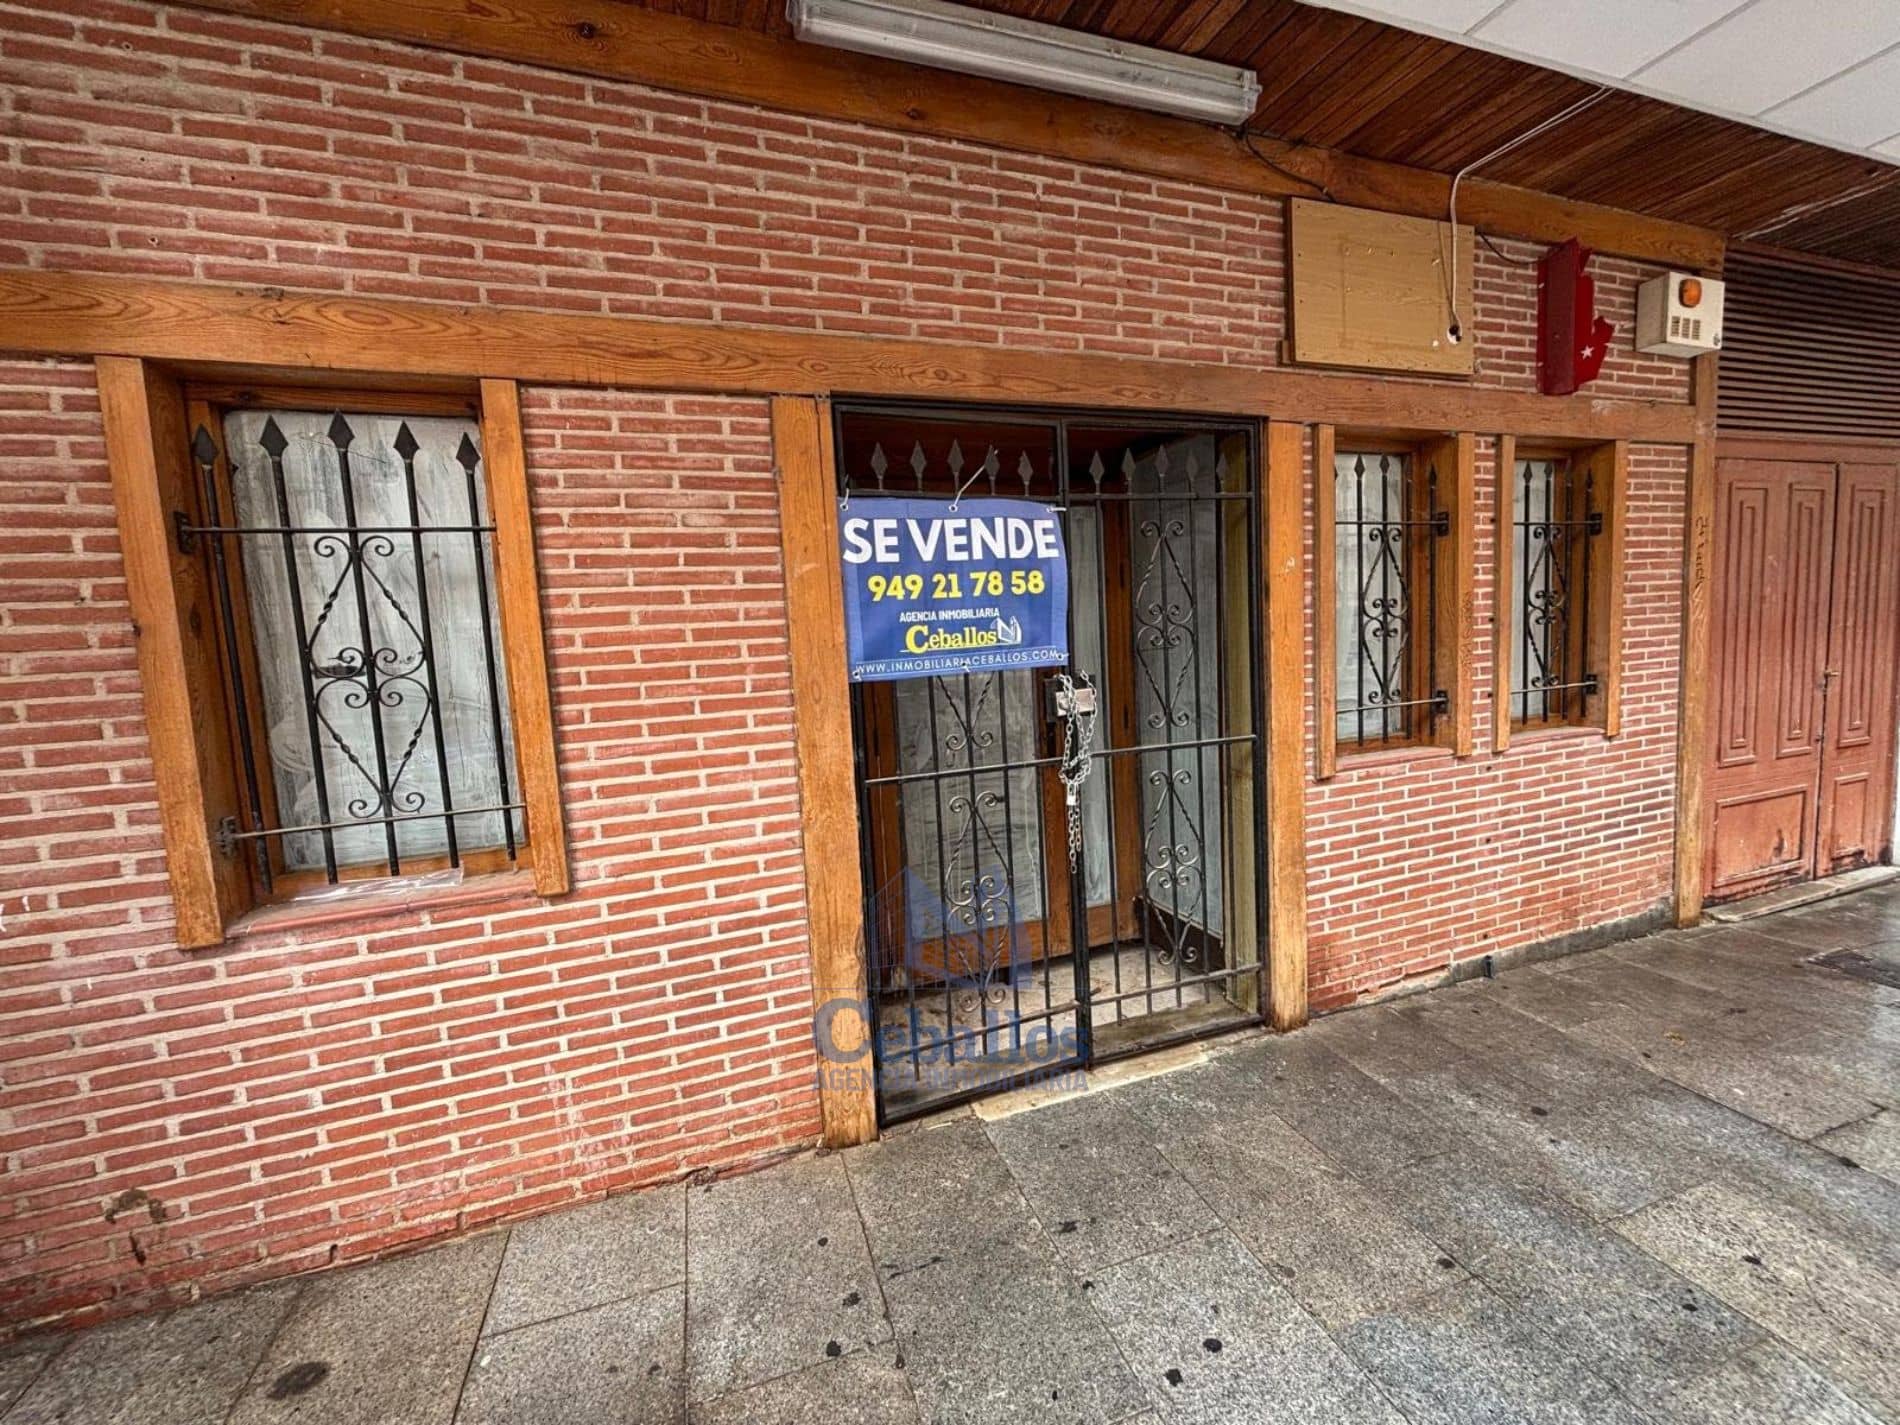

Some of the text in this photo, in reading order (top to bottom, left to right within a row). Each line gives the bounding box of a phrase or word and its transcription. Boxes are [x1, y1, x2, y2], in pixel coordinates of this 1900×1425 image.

[843, 517, 1060, 564] SE VENDE
[868, 570, 1045, 602] 949 21 78 58
[899, 608, 1000, 623] AGENCIA INMOBILIARIA
[905, 624, 998, 654] Ceballos
[856, 650, 1058, 674] WWW.INMOBILIARIACEBALLOS.COM
